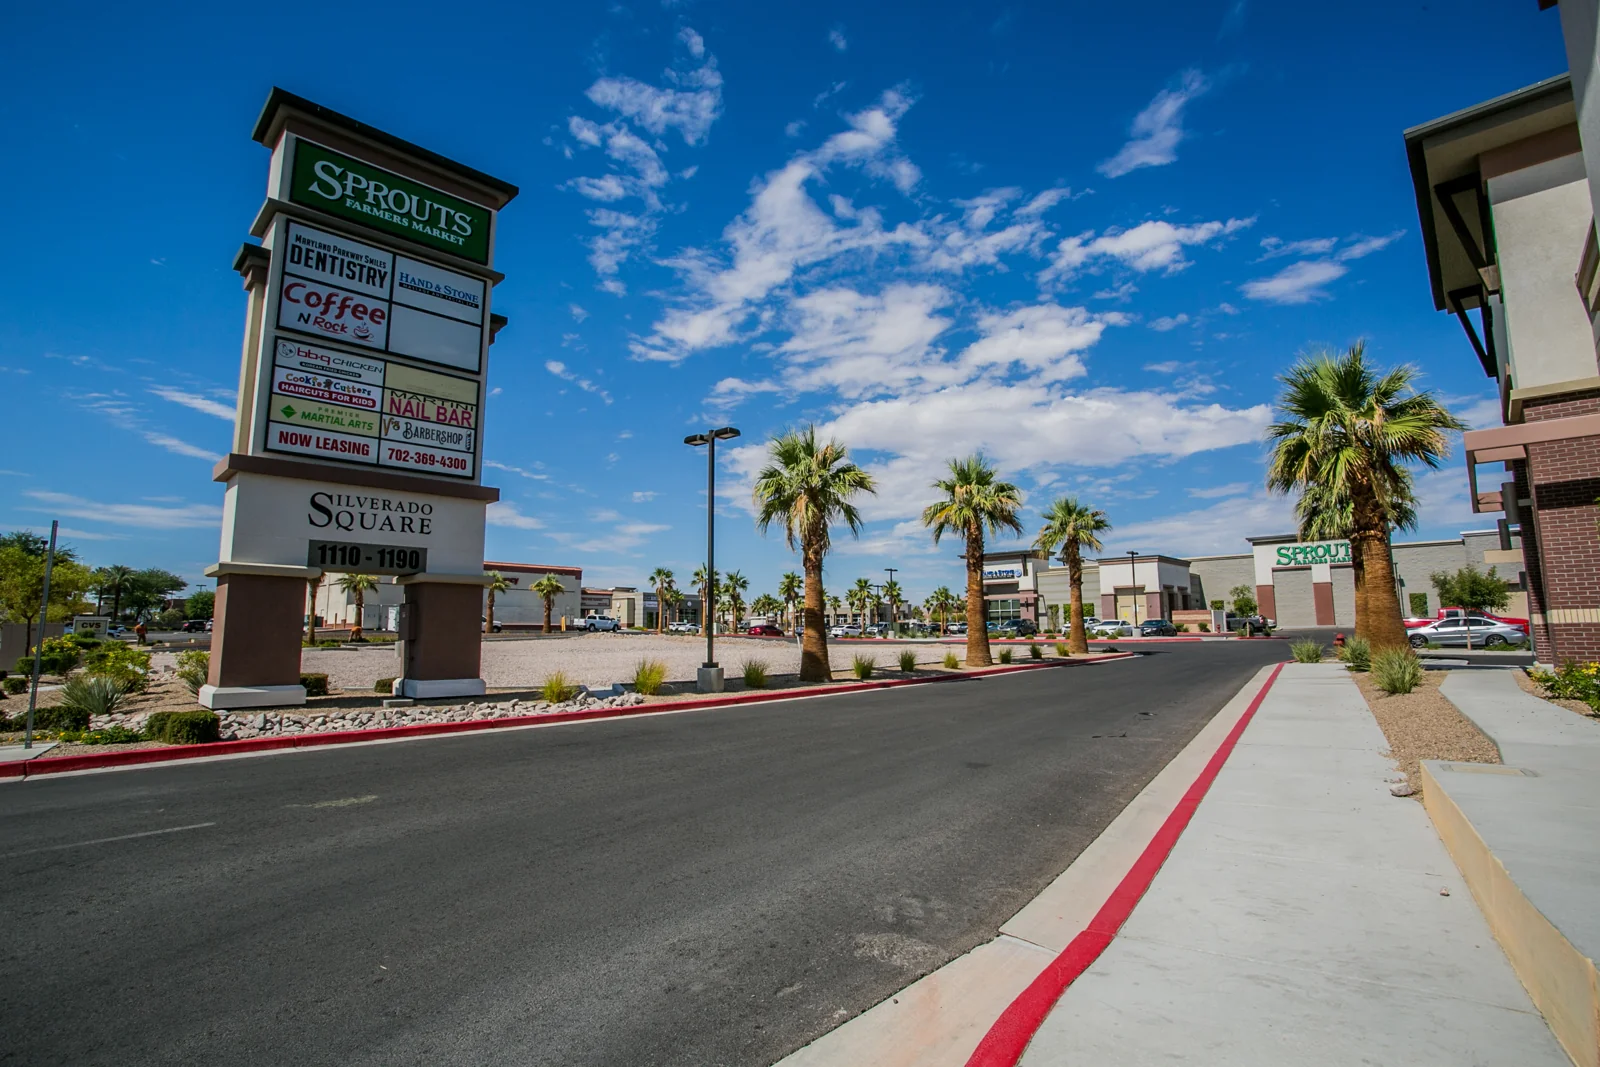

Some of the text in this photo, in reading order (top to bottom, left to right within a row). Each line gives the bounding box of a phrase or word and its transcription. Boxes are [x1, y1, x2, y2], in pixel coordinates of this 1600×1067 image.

[308, 160, 473, 236] SPROUTS
[345, 197, 465, 246] FARMERS MARKET
[295, 234, 387, 269] MARYLAND PARKWAY SMILES
[290, 243, 388, 288] DENTISTRY
[399, 272, 479, 303] HAND & STONE
[284, 282, 386, 325] Coffee
[297, 312, 311, 325] N
[332, 358, 383, 373] CHICKEN
[281, 383, 373, 406] HAIRCUTS FOR KIDS
[285, 373, 372, 396] Cookie Cutters
[318, 406, 360, 418] PREMIER
[389, 396, 472, 428] NAIL BAR
[390, 390, 474, 412] MARTINI
[301, 411, 374, 431] MARTIAL ARTS
[278, 430, 370, 456] NOW LEASING
[387, 447, 467, 471] 702-369-4300
[308, 491, 433, 527] SILVERADO
[318, 544, 361, 567] 1110
[377, 547, 420, 570] 1190
[1276, 542, 1351, 565] SPROUT
